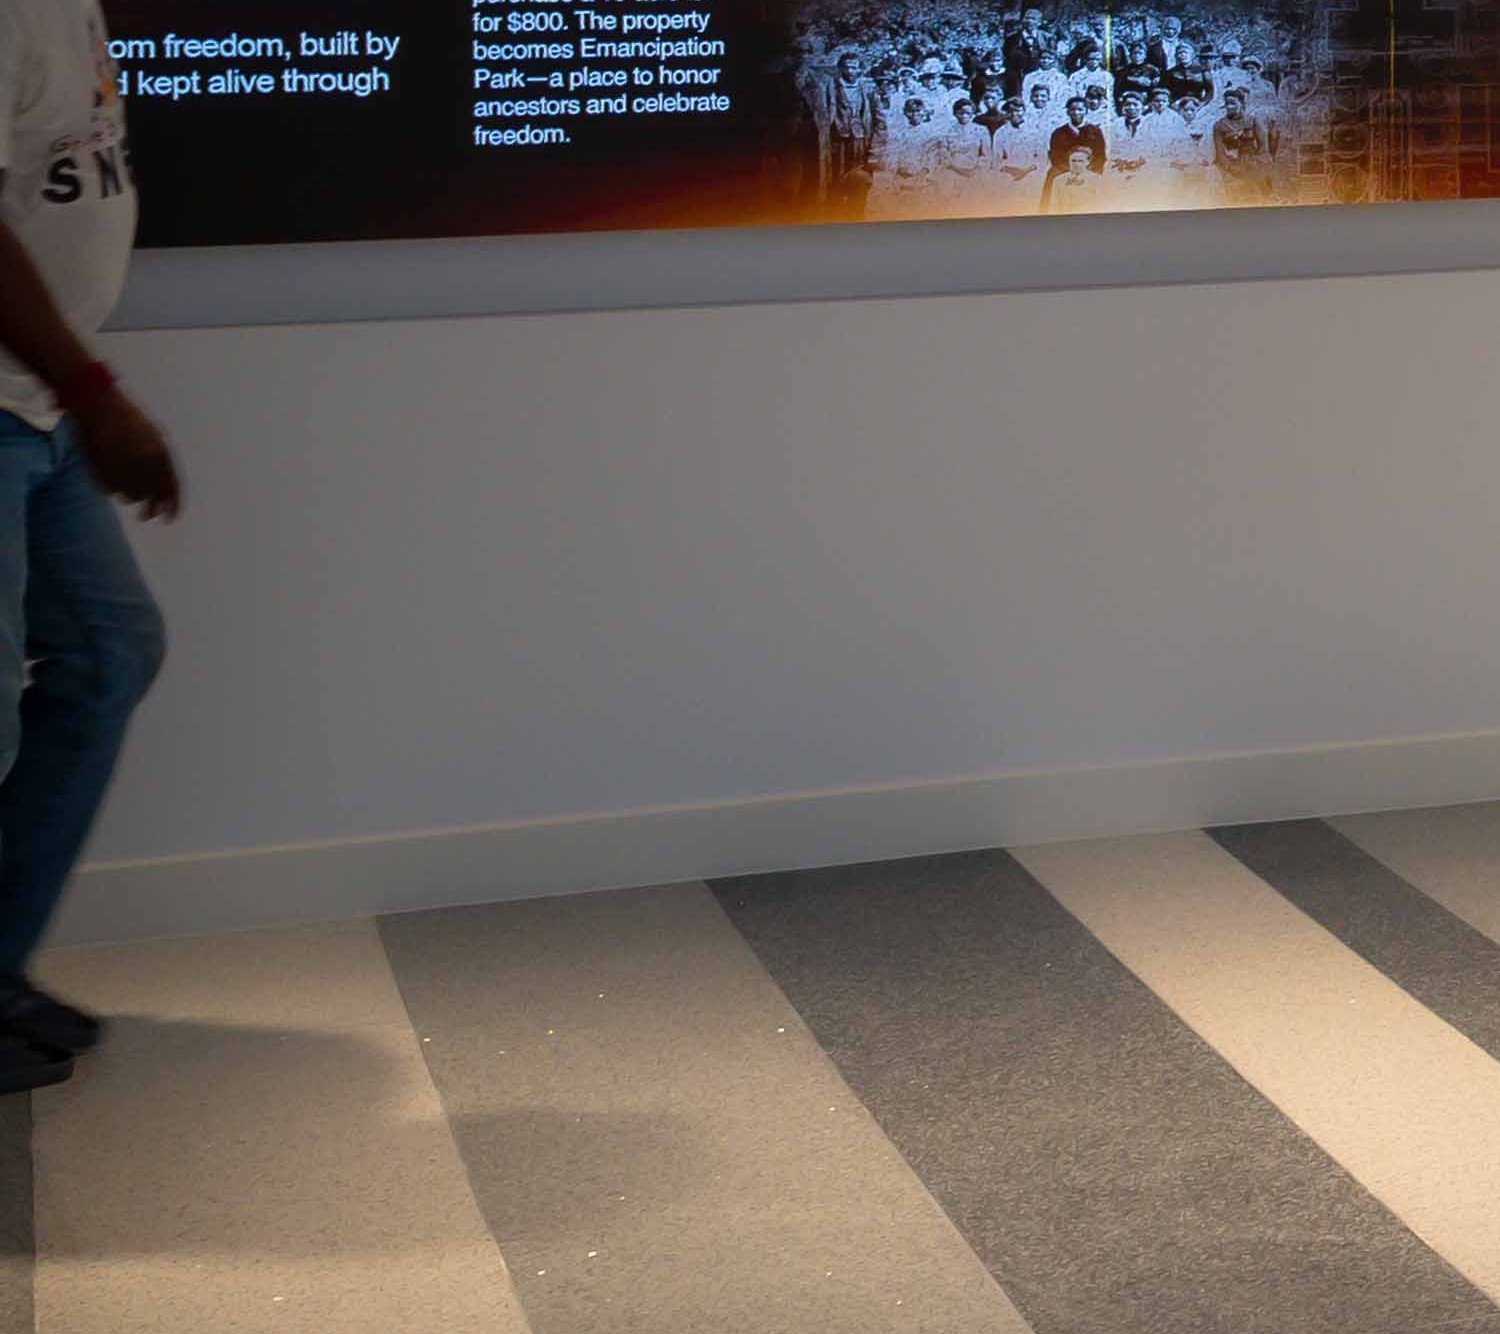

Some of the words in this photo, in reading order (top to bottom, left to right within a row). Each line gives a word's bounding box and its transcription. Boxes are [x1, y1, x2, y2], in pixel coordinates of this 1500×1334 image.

[163, 31, 292, 61] freedom,
[299, 29, 359, 57] built
[365, 29, 400, 60] by
[473, 39, 574, 61] becomes
[580, 35, 725, 61] Emancipation
[136, 70, 202, 101] kept
[207, 70, 275, 95] alive
[281, 67, 391, 98] through
[474, 97, 581, 117] ancestors
[585, 93, 627, 115] and
[632, 91, 730, 113] celebrate
[473, 123, 571, 146] freedom.
